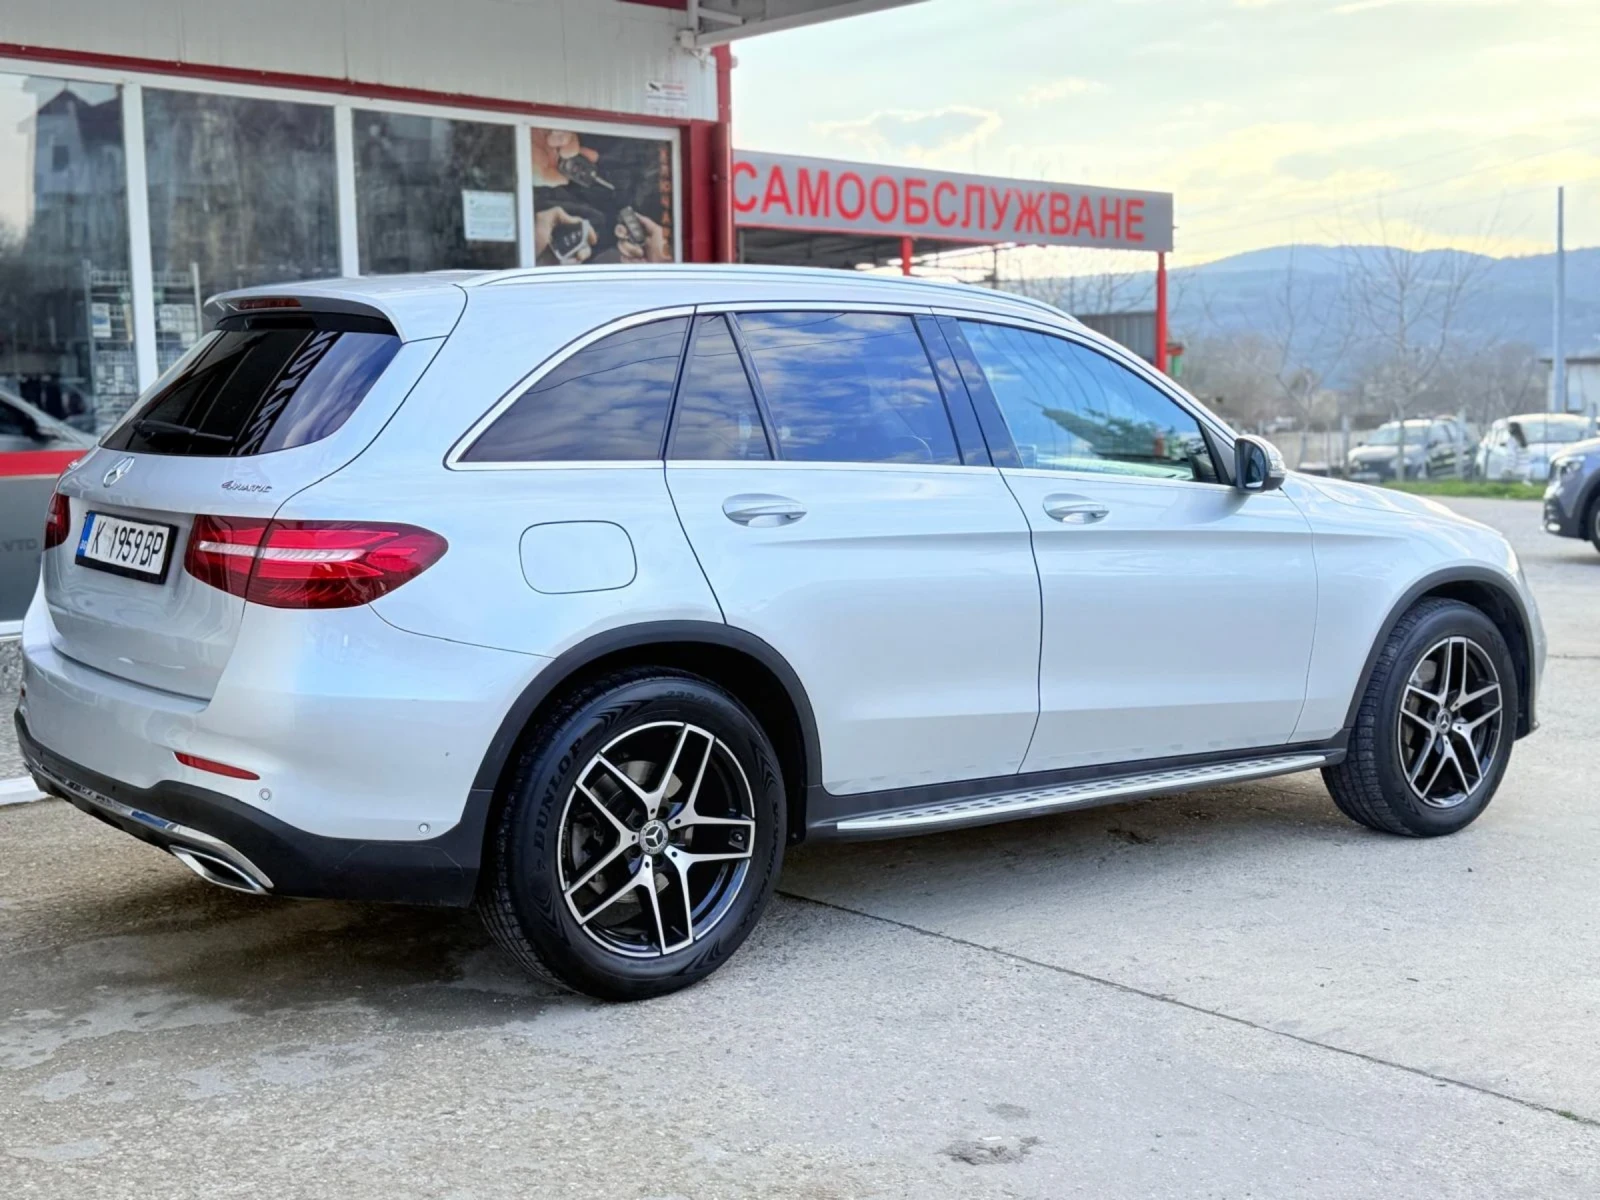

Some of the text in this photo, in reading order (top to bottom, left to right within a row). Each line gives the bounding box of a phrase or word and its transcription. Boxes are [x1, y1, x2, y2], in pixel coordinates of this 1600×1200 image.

[733, 161, 1146, 242] САМООБСЛУЖВАНЕ
[91, 520, 107, 555] K
[534, 737, 583, 850] DUNLOP
